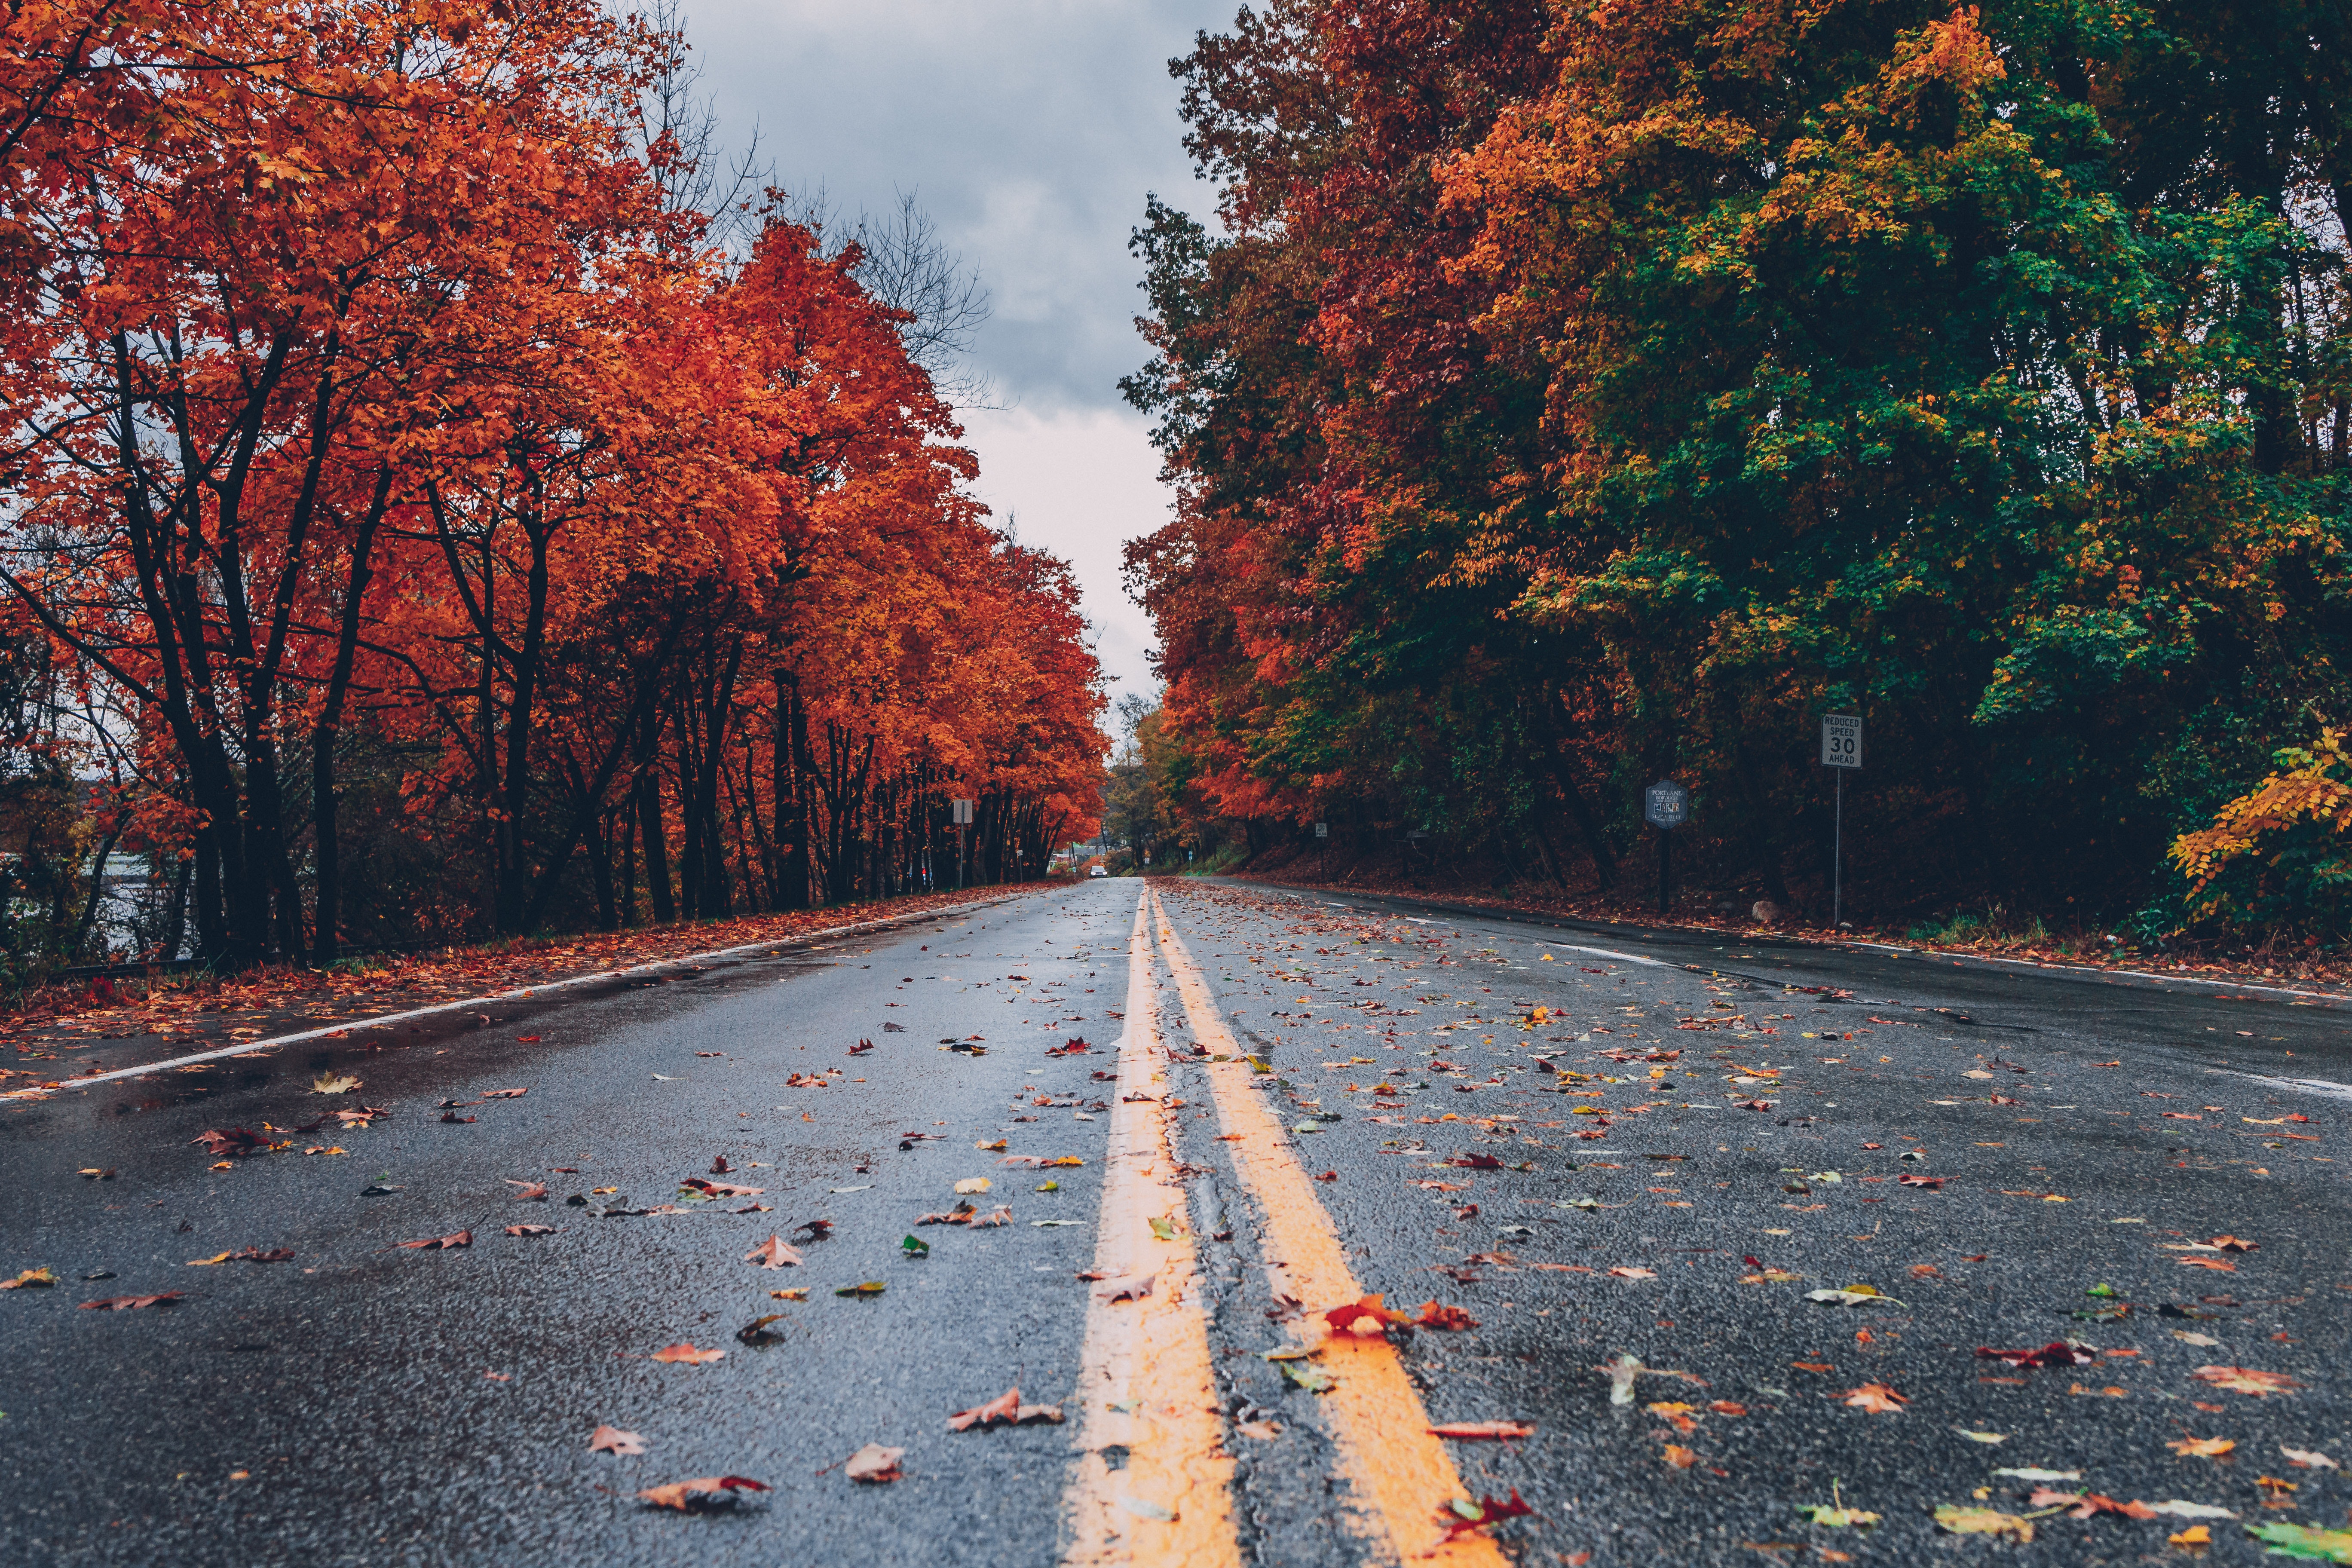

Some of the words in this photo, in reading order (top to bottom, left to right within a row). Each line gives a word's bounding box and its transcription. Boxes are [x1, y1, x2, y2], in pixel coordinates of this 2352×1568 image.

[1825, 717, 1859, 727] REDUCED
[1830, 727, 1854, 737] SPEED
[1830, 737, 1855, 754] 30
[1829, 755, 1854, 764] AHEAD
